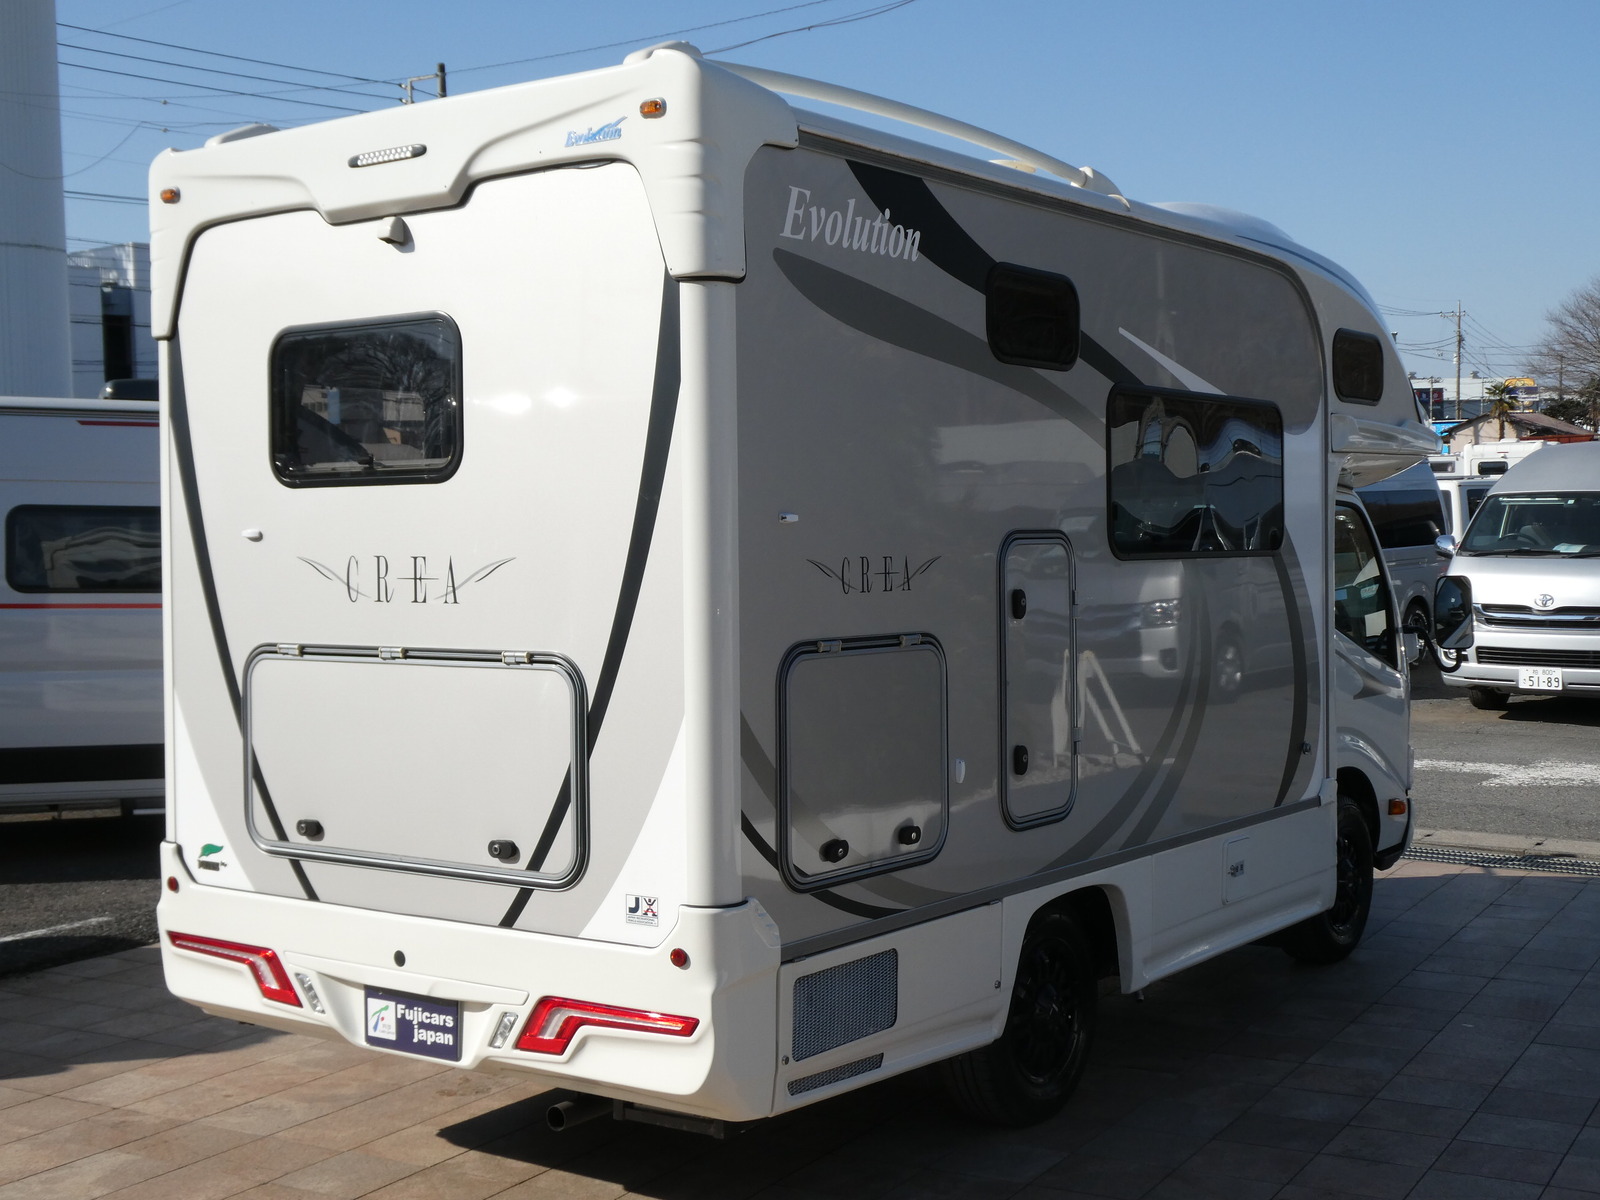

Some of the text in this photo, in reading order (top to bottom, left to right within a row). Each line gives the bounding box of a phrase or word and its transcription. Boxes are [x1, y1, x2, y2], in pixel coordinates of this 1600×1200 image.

[779, 185, 921, 262] Evolution
[346, 555, 460, 604] CREA
[841, 555, 912, 595] CREA
[1528, 675, 1560, 688] 51-89
[396, 1003, 454, 1028] Fujicars
[412, 1024, 454, 1046] japan
